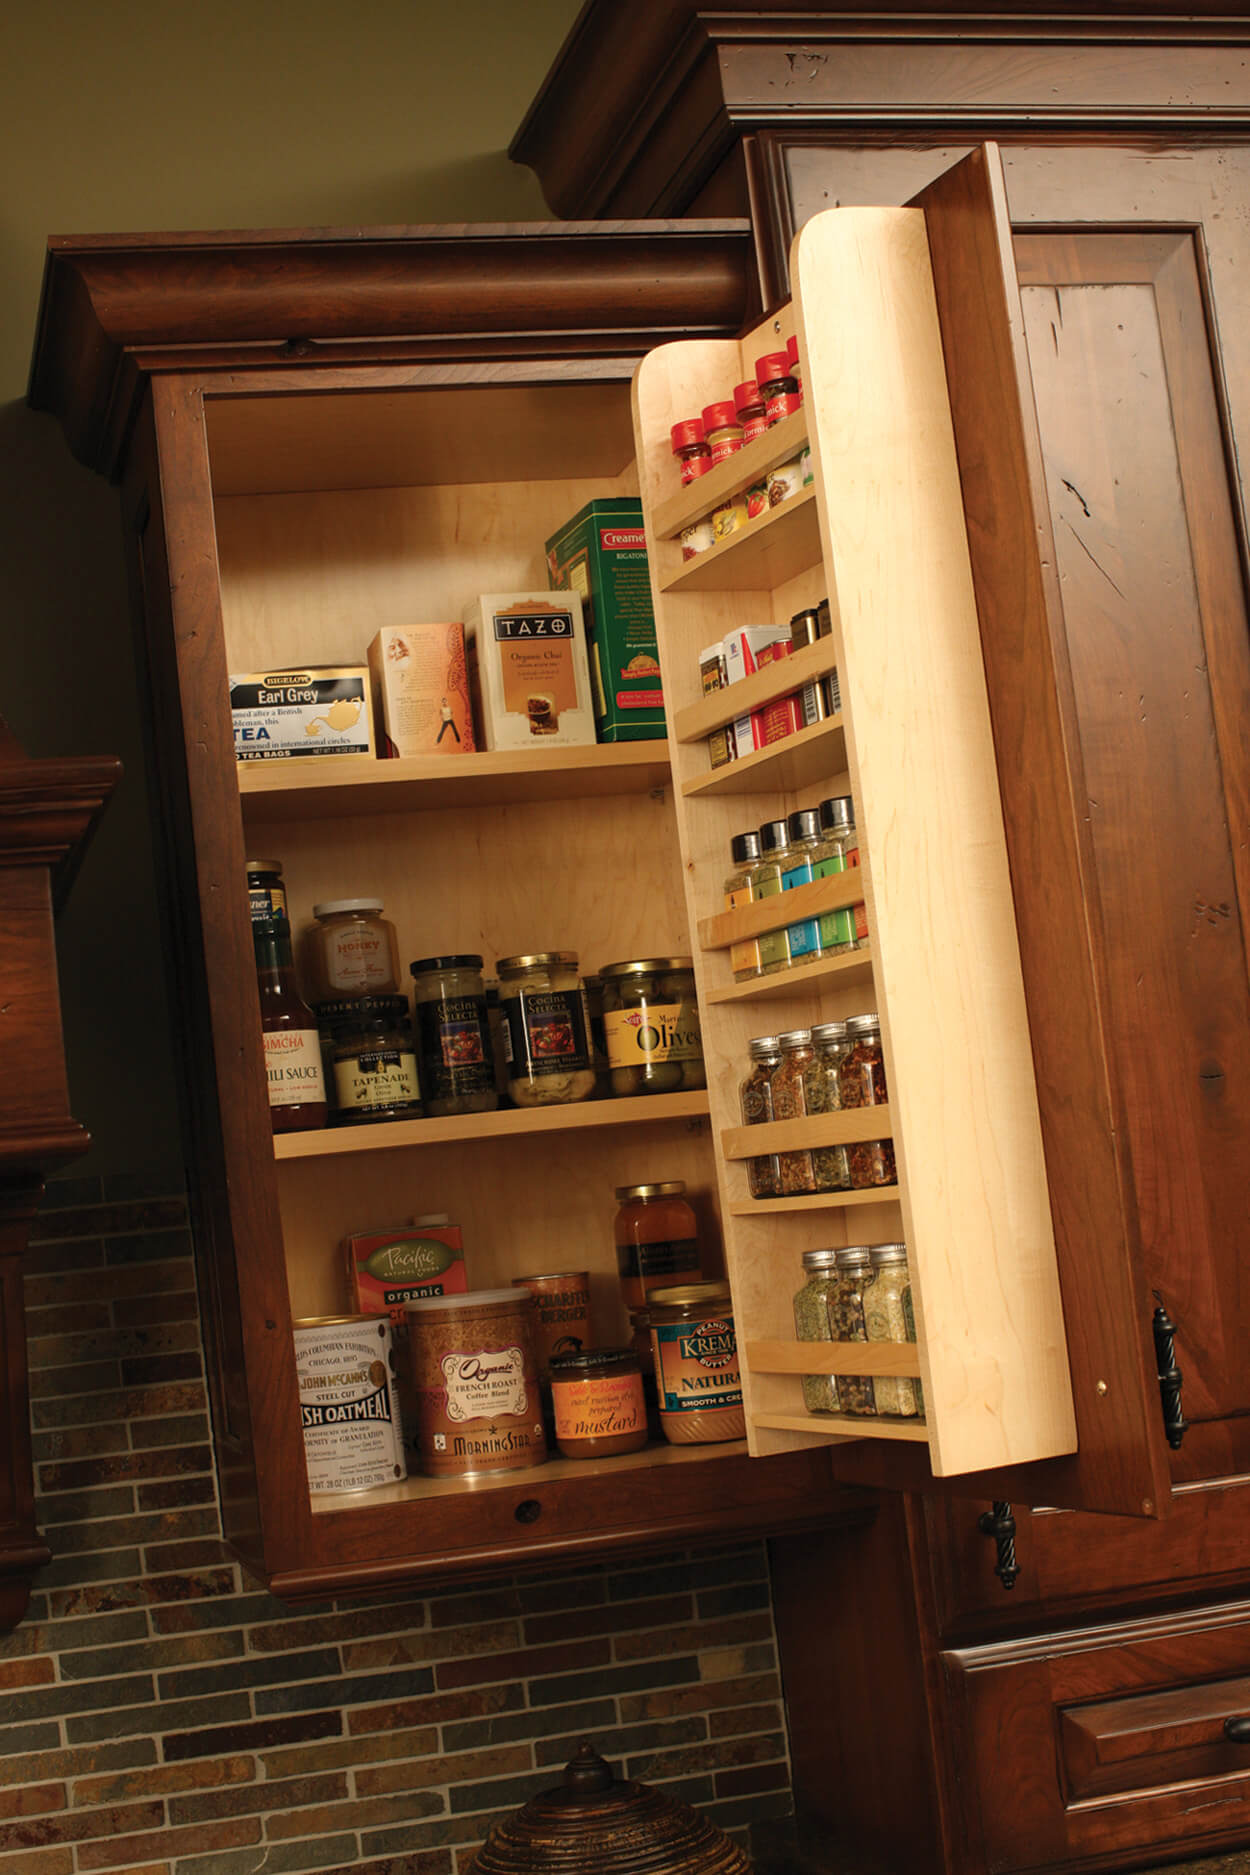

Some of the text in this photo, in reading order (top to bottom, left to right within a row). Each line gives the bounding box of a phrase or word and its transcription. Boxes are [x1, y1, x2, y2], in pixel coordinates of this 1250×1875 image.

[603, 532, 646, 546] Creame
[501, 618, 566, 635] TAZO
[267, 676, 308, 685] BIGELOW
[258, 687, 319, 705] Earl Grey
[243, 752, 262, 760] TEA
[264, 750, 291, 759] BAGS
[268, 1065, 319, 1081] ILI SAUCE
[383, 1246, 435, 1270] Pacific
[388, 1287, 441, 1303] organic
[696, 1321, 729, 1336] PEANUT
[700, 1354, 731, 1368] BUTTER
[459, 1358, 514, 1382] Organic
[300, 1375, 327, 1390] JOHN
[456, 1379, 518, 1393] FRENCH ROAST
[316, 1390, 356, 1401] STEEL CUT
[466, 1389, 510, 1401] Coffee Blend
[681, 1398, 717, 1408] SMOOTH
[718, 1396, 725, 1404] &
[326, 1388, 390, 1422] OATMEAL
[575, 1410, 638, 1436] mustard
